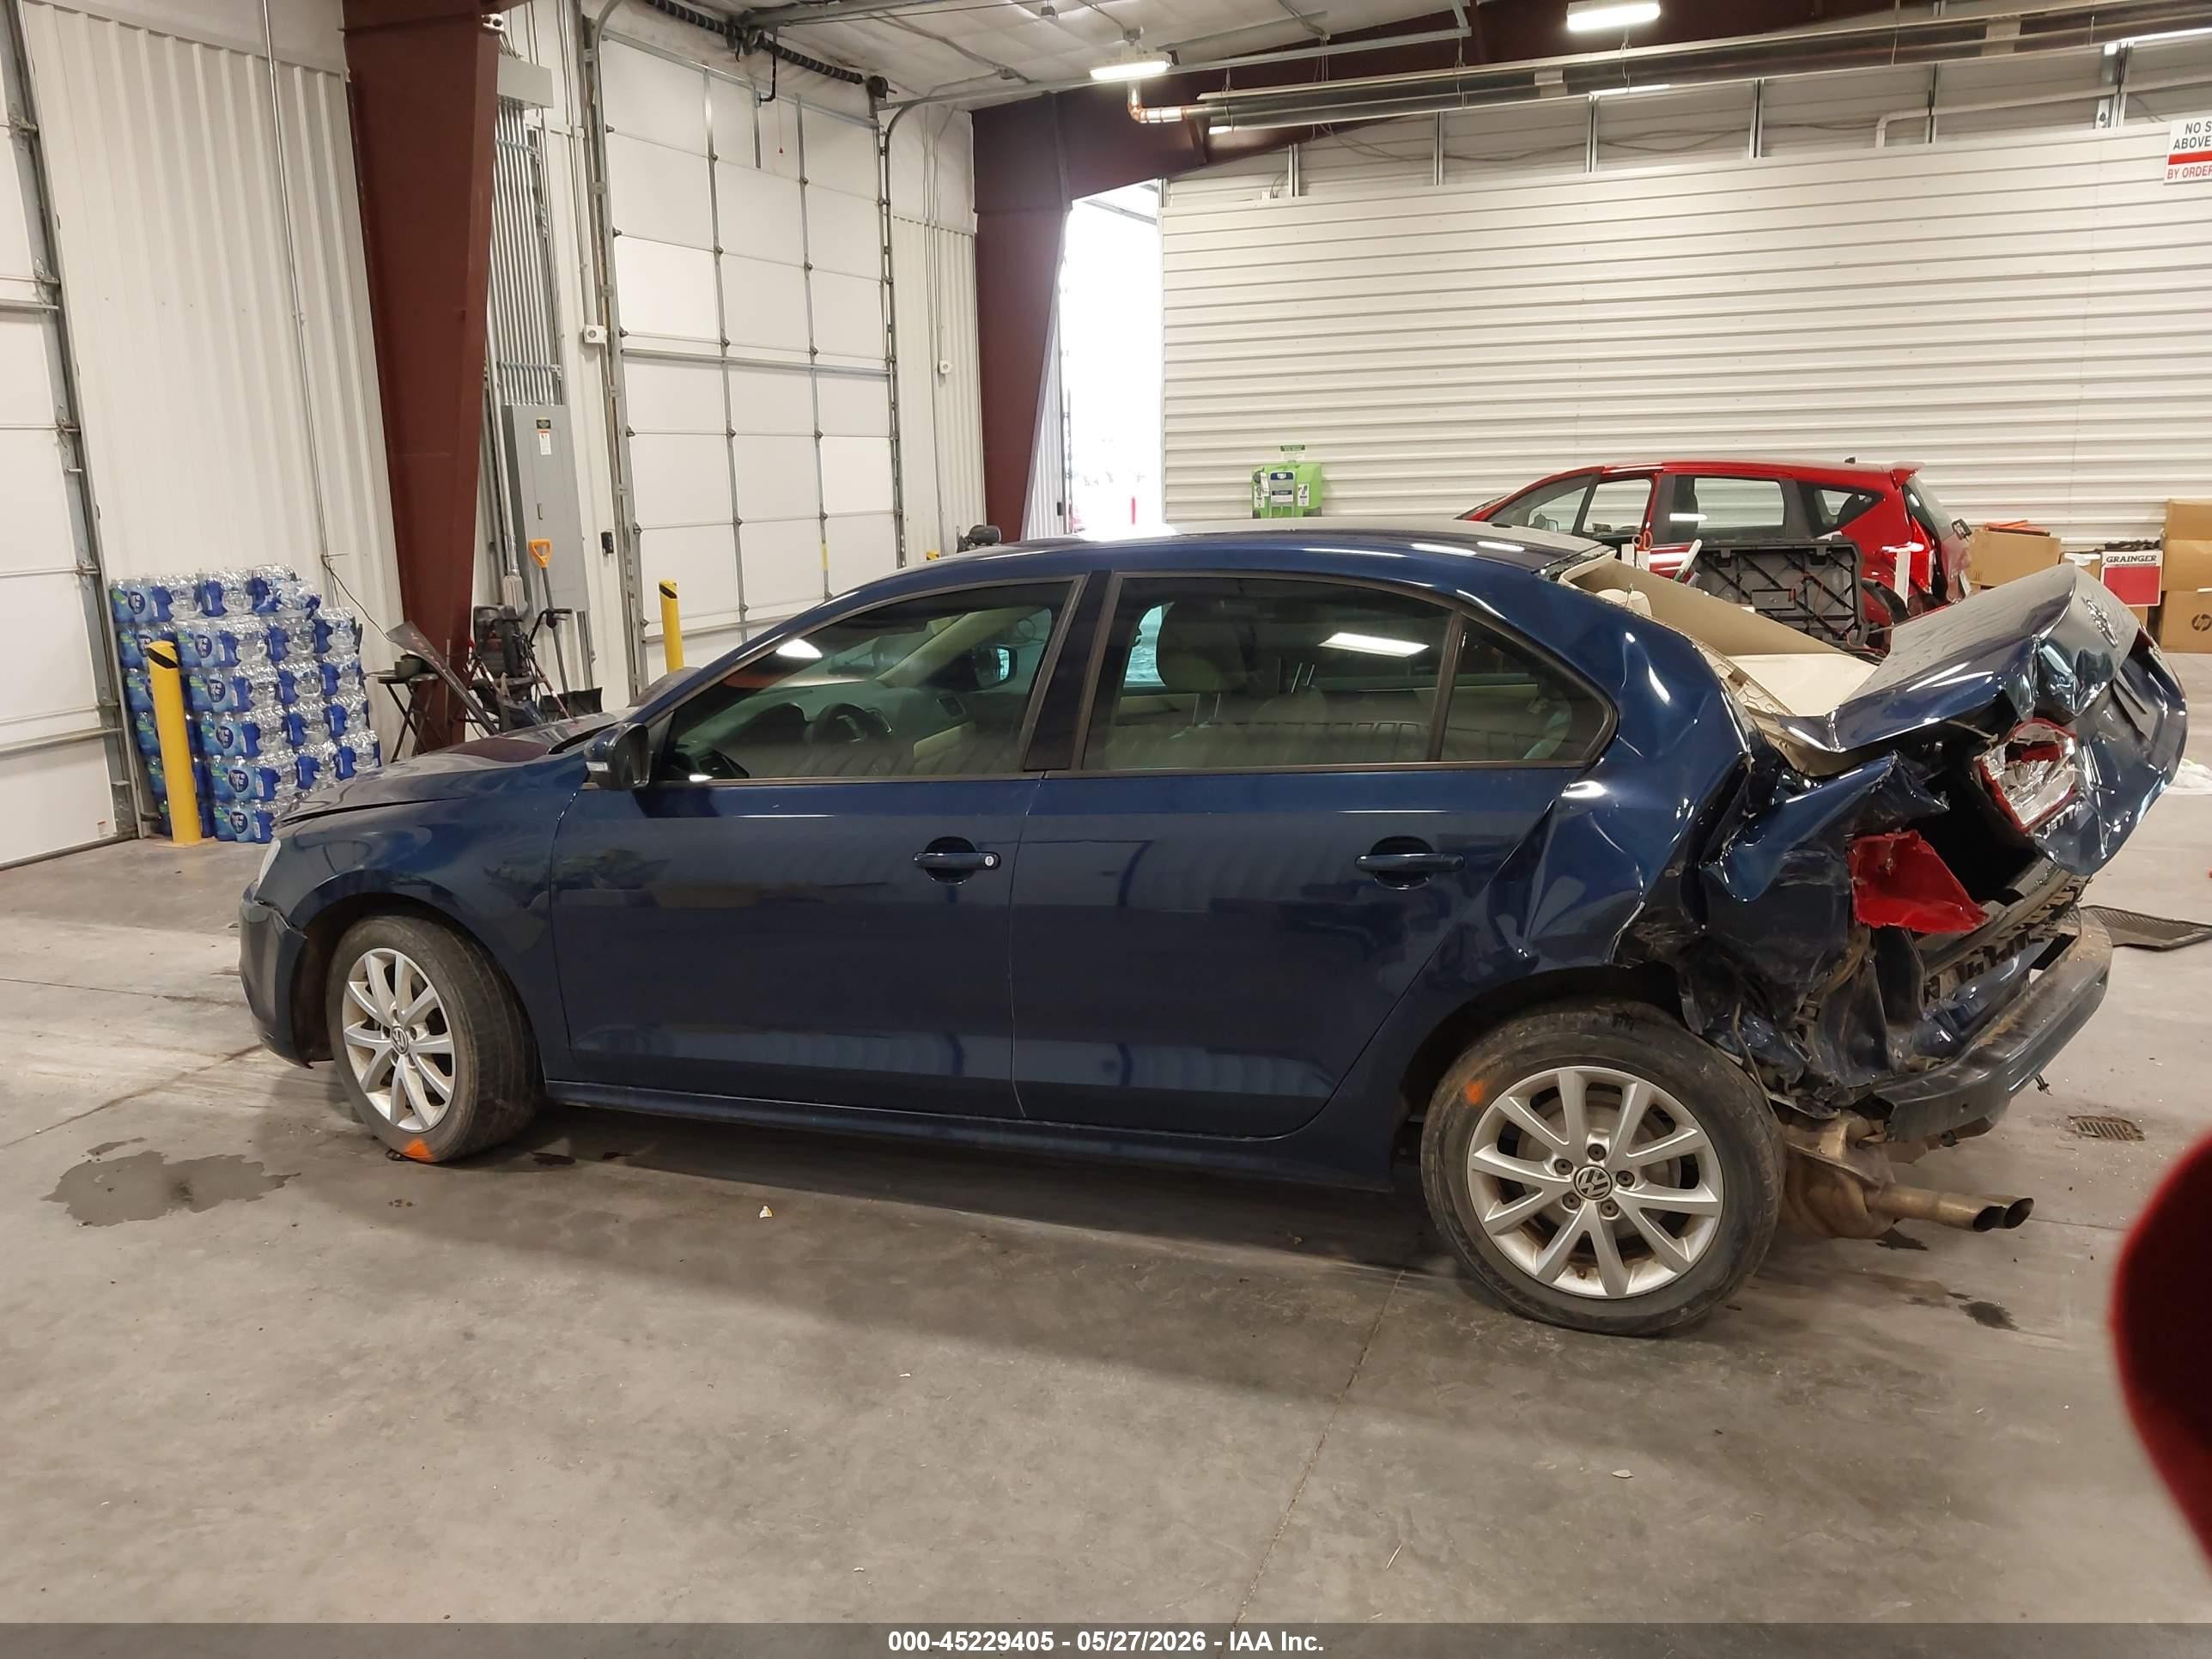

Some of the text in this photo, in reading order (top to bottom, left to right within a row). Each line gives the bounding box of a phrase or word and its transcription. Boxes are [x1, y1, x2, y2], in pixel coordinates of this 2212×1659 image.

[2185, 122, 2201, 135] NO
[2172, 135, 2212, 150] ABOVE
[2166, 167, 2180, 179] BY
[2106, 555, 2157, 563] GRAINGER
[2043, 800, 2082, 840] JETTA
